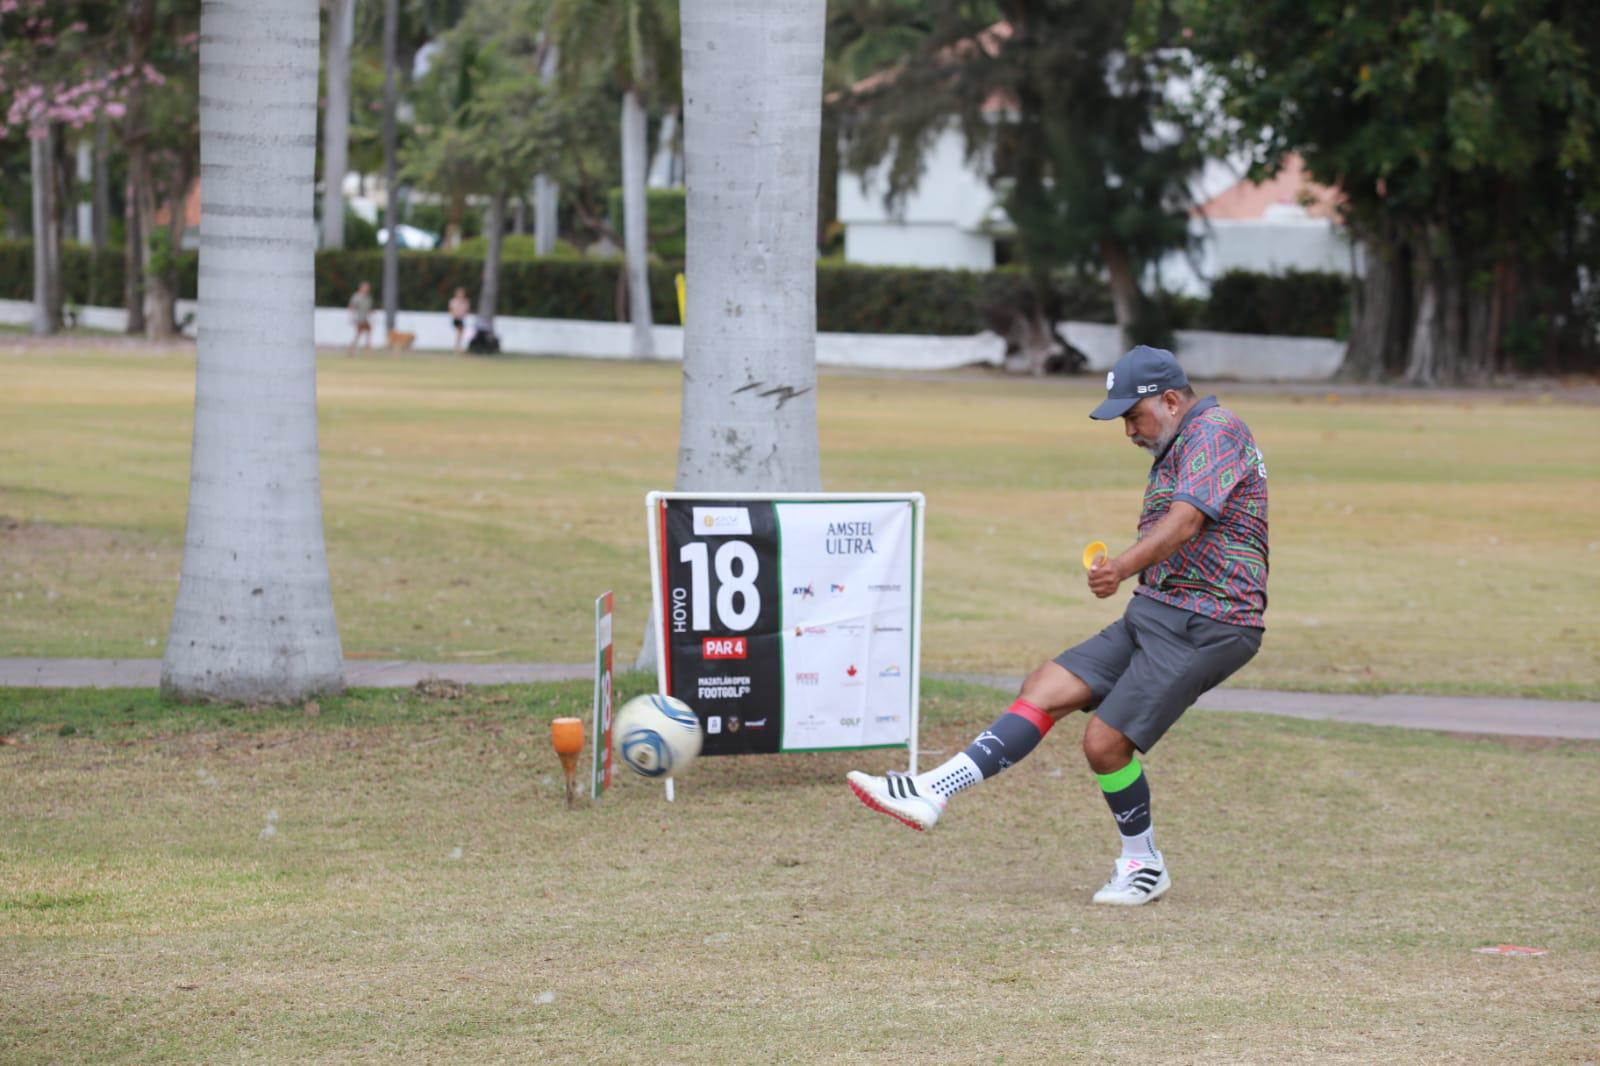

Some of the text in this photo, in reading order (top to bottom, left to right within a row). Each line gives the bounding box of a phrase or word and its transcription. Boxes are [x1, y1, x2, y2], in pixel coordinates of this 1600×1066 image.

[1136, 384, 1158, 394] SC
[827, 522, 873, 536] AMSTEL
[826, 538, 876, 555] ULTRA
[680, 540, 761, 631] 18
[672, 587, 687, 633] HOYO
[705, 640, 744, 655] PAR 4
[732, 676, 751, 685] OPEN
